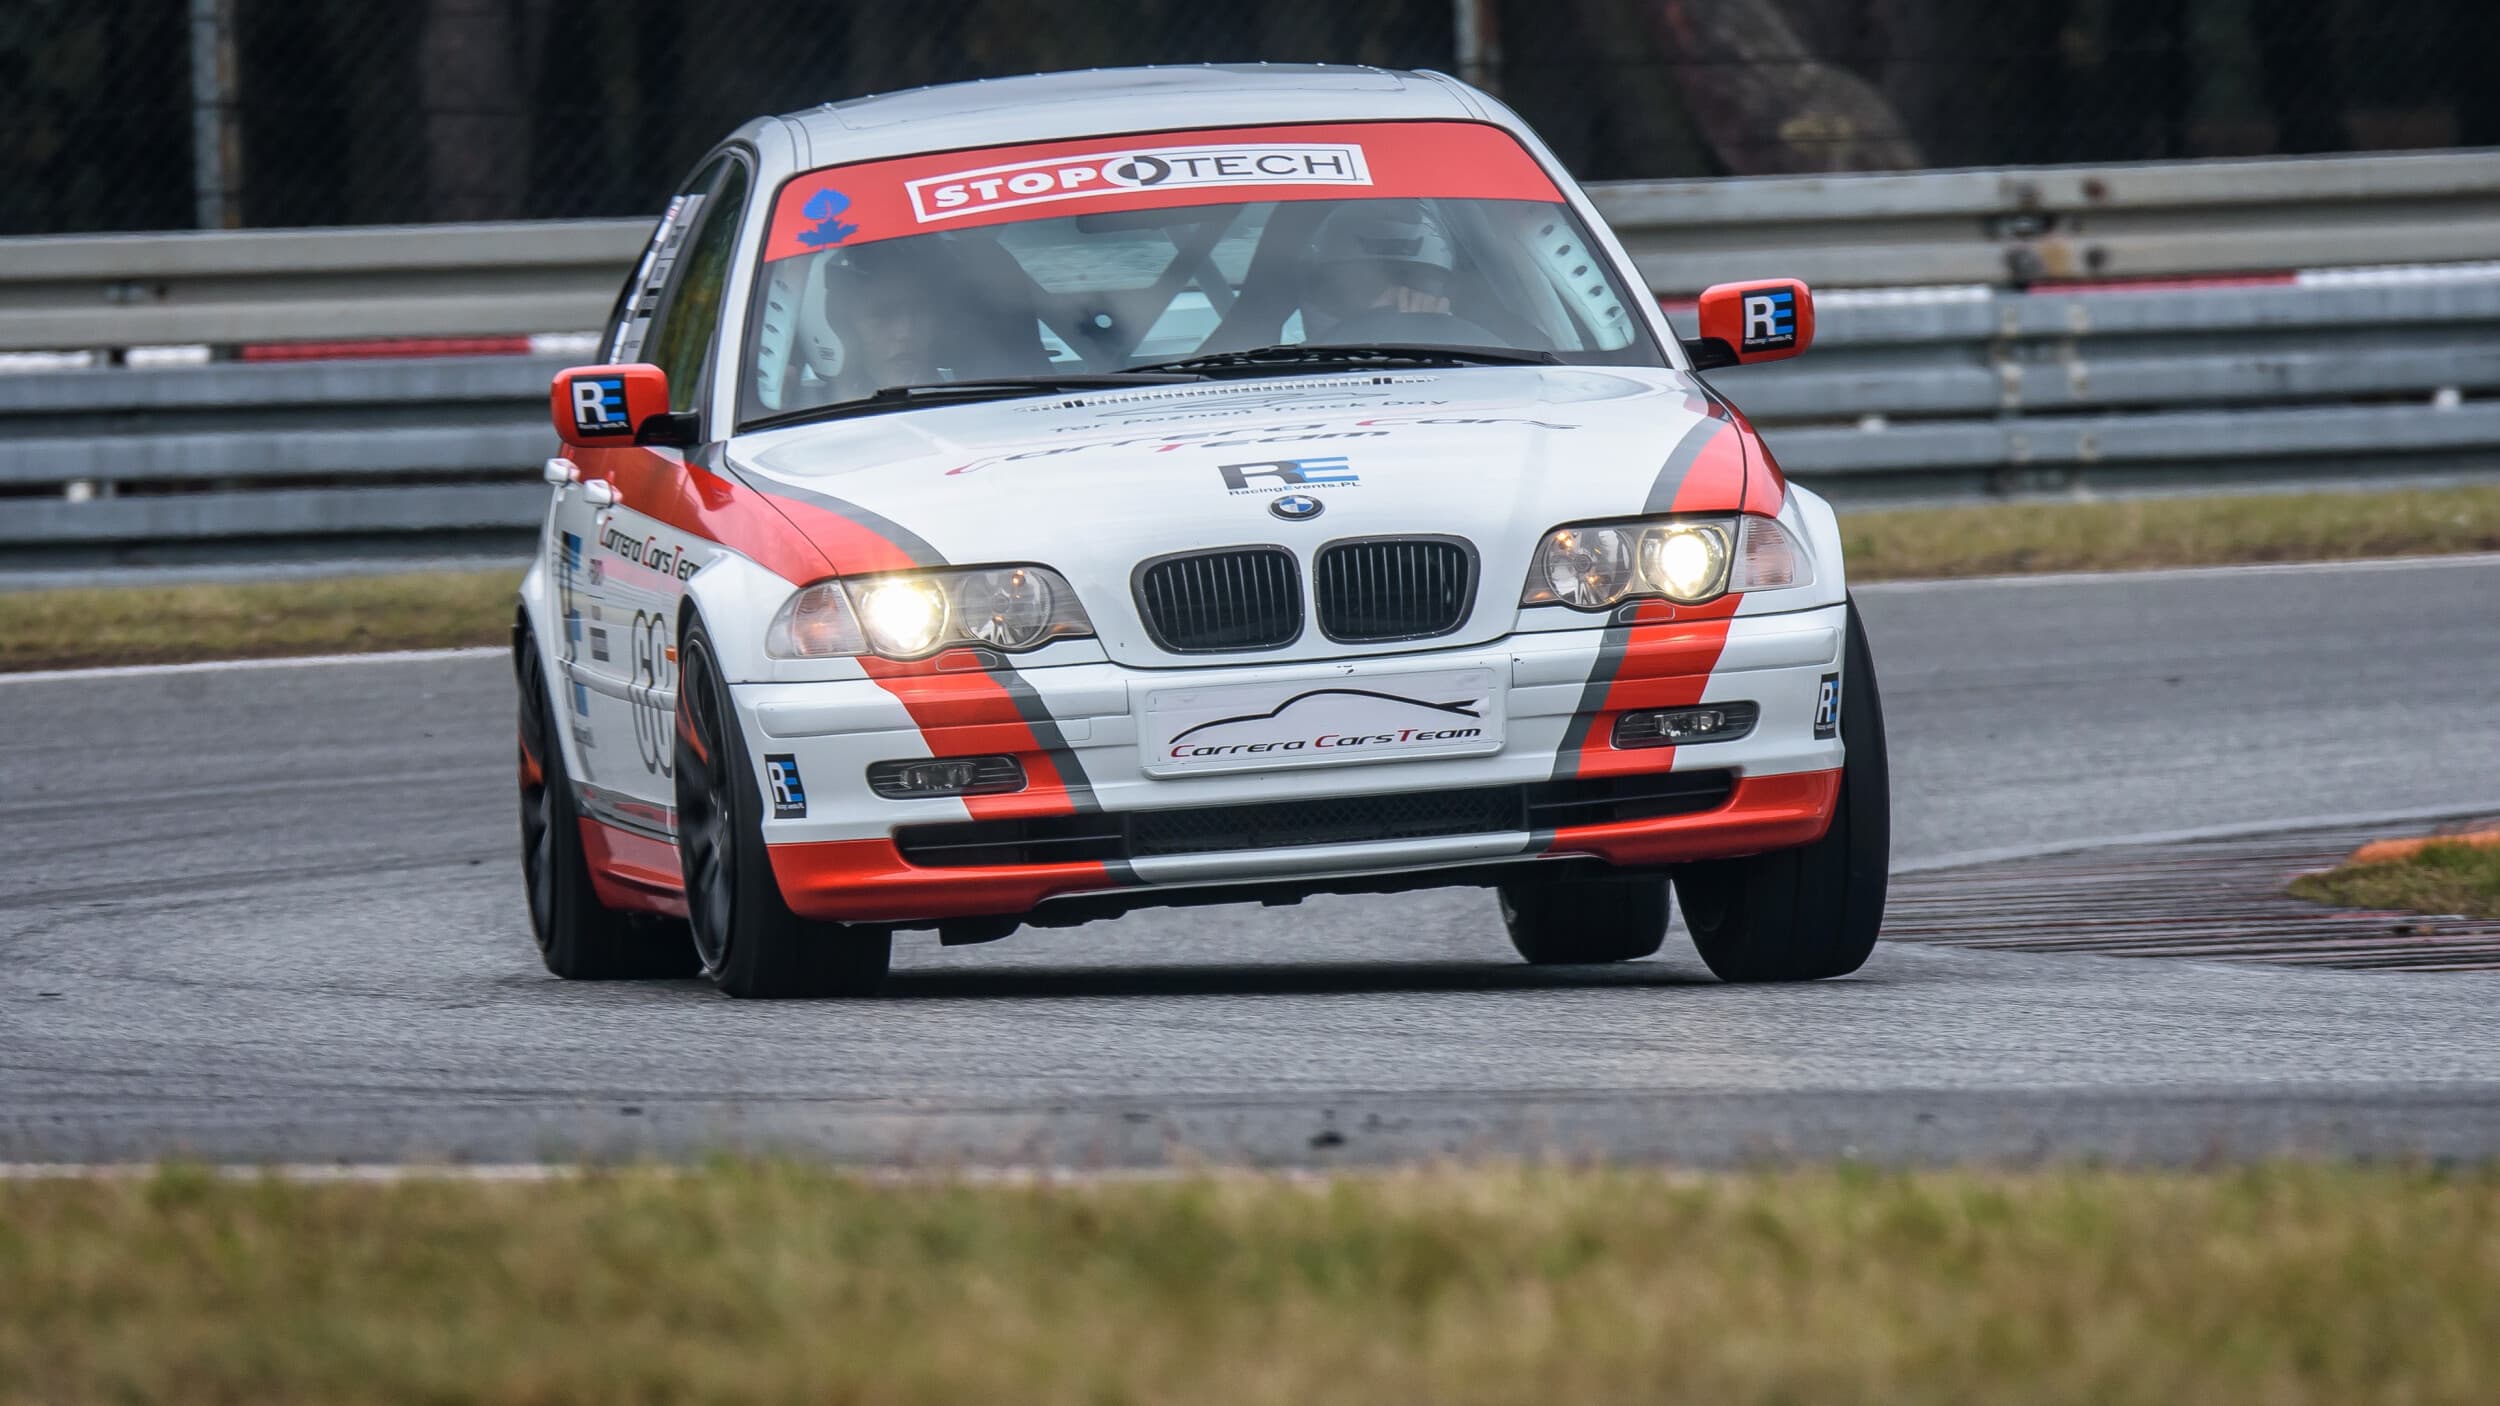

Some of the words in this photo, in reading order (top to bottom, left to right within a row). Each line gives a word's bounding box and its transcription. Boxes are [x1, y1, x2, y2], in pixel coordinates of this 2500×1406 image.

[1743, 292, 1794, 338] RE
[572, 380, 627, 423] RE
[944, 423, 1327, 476] Carrera
[1150, 430, 1391, 454] Team
[1217, 456, 1360, 490] RE
[1228, 481, 1363, 496] RacingEvents.PL
[1816, 680, 1839, 723] RE
[1170, 739, 1305, 760] Carrera
[766, 761, 804, 802] RE
